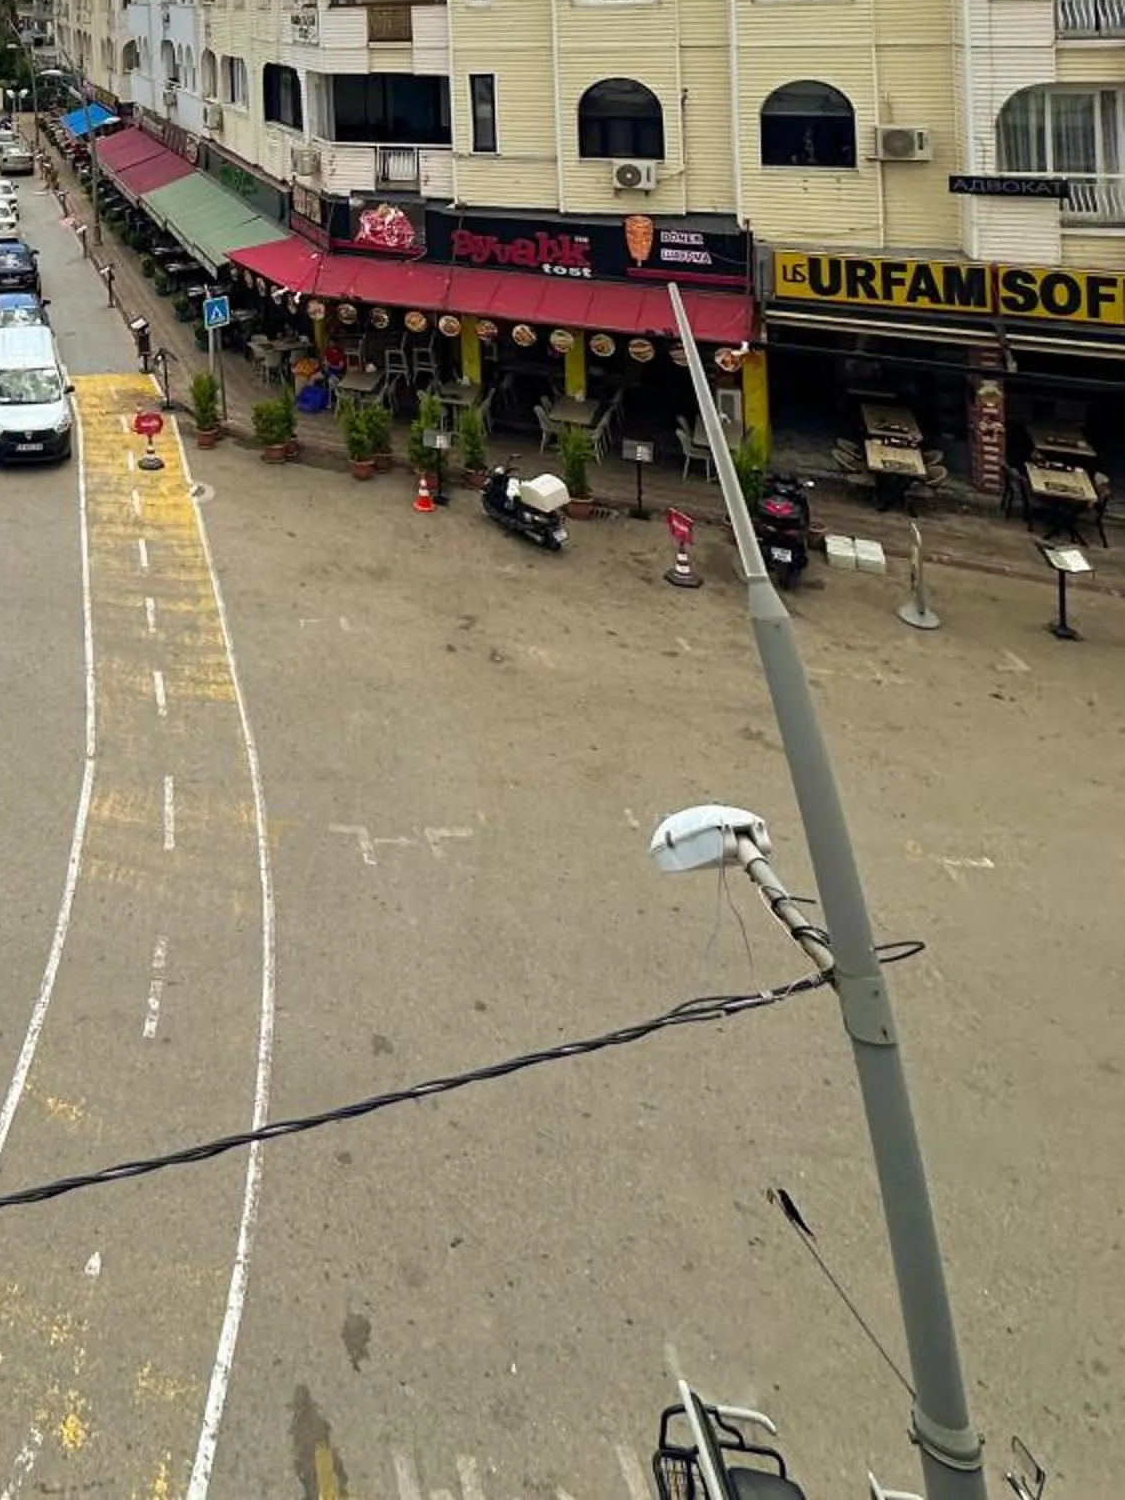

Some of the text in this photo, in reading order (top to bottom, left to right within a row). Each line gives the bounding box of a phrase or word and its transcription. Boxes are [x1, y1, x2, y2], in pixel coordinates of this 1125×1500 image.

[953, 178, 1062, 196] АДВОКАТ
[542, 263, 593, 278] tost
[808, 257, 987, 307] URFAM
[1001, 269, 1125, 319] SOF
